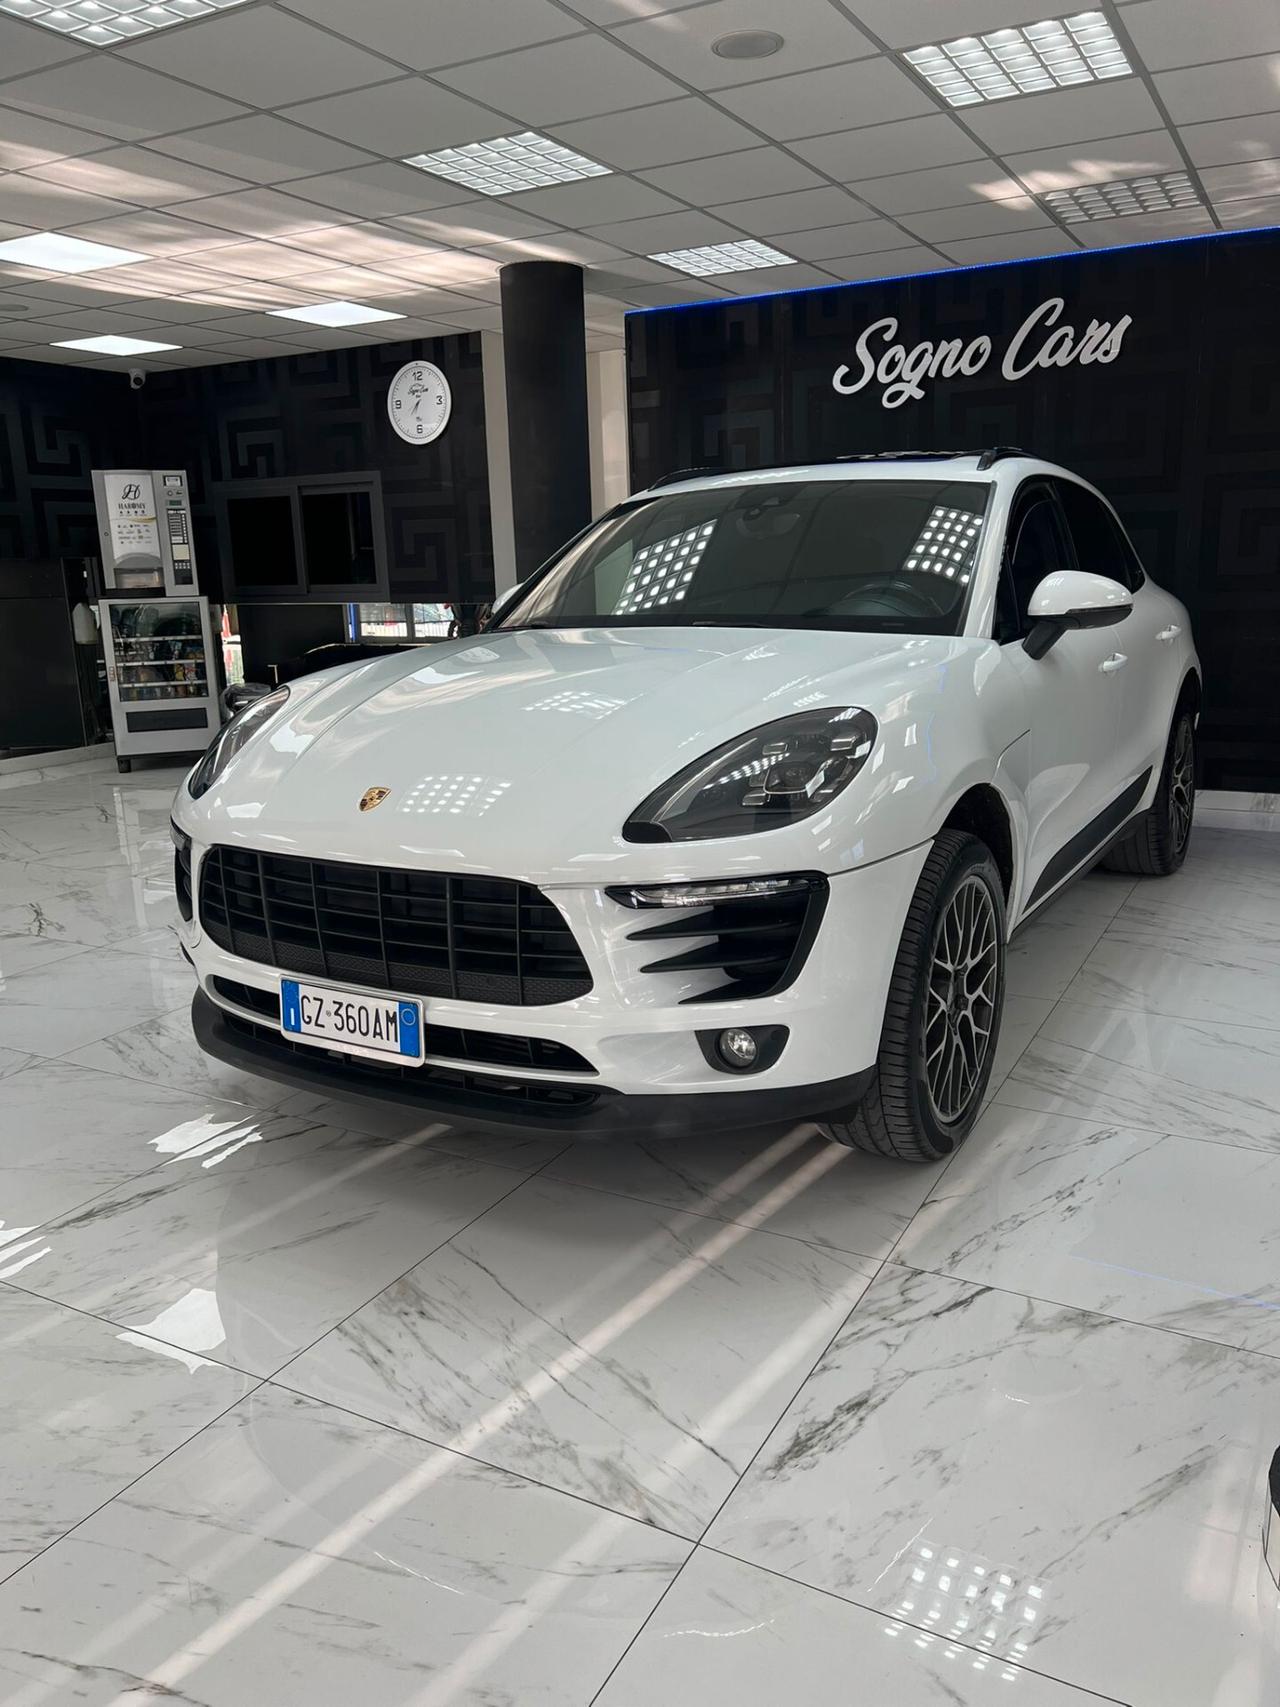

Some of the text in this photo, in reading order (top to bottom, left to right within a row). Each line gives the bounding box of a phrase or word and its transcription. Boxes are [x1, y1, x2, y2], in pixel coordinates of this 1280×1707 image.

[832, 297, 1133, 410] Sogno Cars
[412, 371, 423, 381] 12
[395, 400, 402, 409] 9
[436, 395, 443, 405] 3
[416, 425, 423, 434] 6
[301, 995, 325, 1028] GZ
[332, 1000, 399, 1043] 360AM
